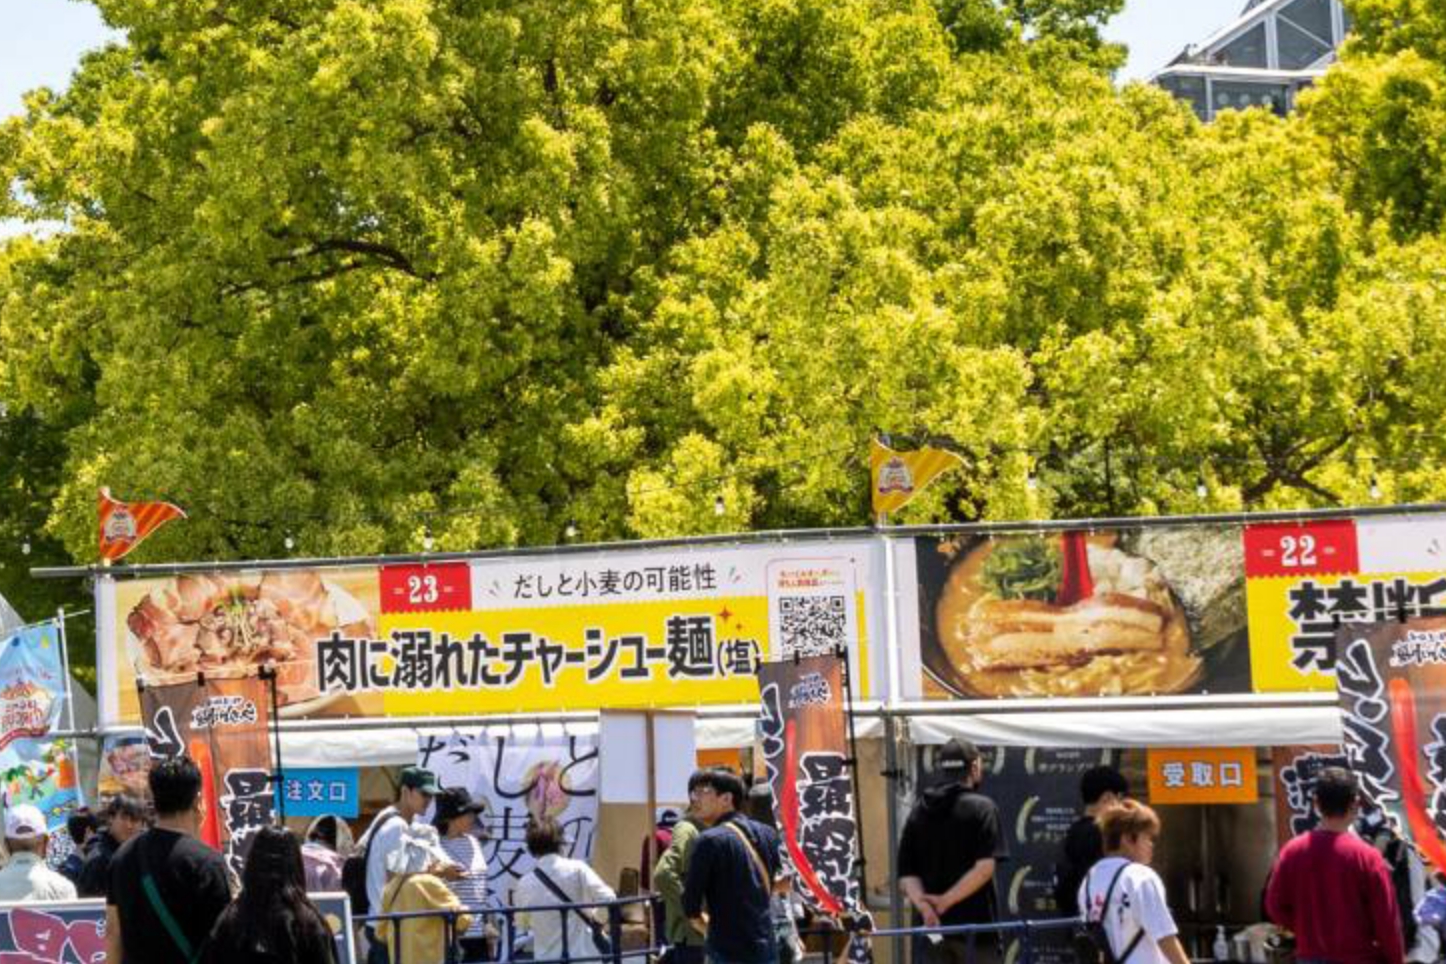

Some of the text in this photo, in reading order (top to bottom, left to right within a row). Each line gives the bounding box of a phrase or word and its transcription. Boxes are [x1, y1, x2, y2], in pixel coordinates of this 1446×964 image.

[1280, 535, 1317, 567] 22
[408, 574, 440, 604] 23
[513, 563, 717, 599] だしと小麦の可能性
[1162, 762, 1242, 787] 受取口
[285, 780, 346, 801] 注文口
